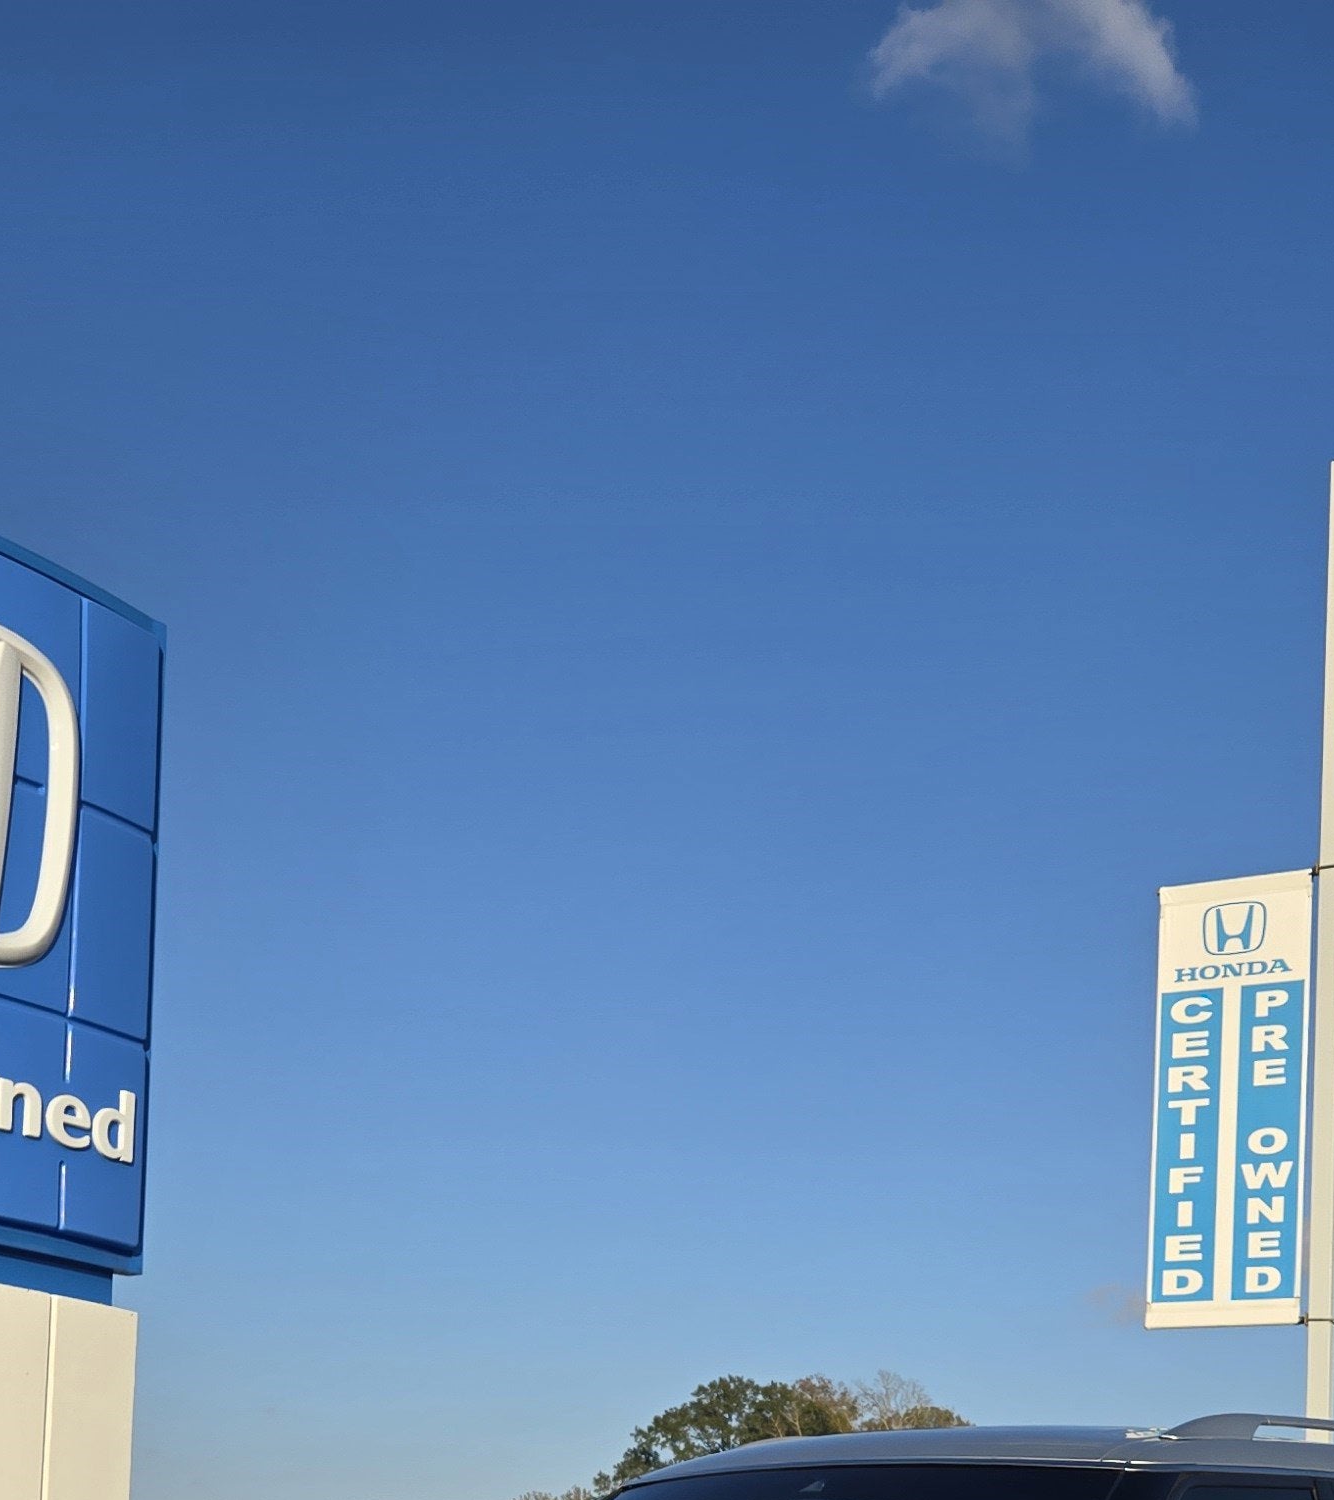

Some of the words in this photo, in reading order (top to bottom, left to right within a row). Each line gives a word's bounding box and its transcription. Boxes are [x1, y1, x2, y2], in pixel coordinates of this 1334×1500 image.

[1174, 957, 1293, 983] HONDA
[1250, 989, 1290, 1087] PRE
[1161, 996, 1214, 1297] CERTIFIED
[1241, 1127, 1294, 1294] OWNED
